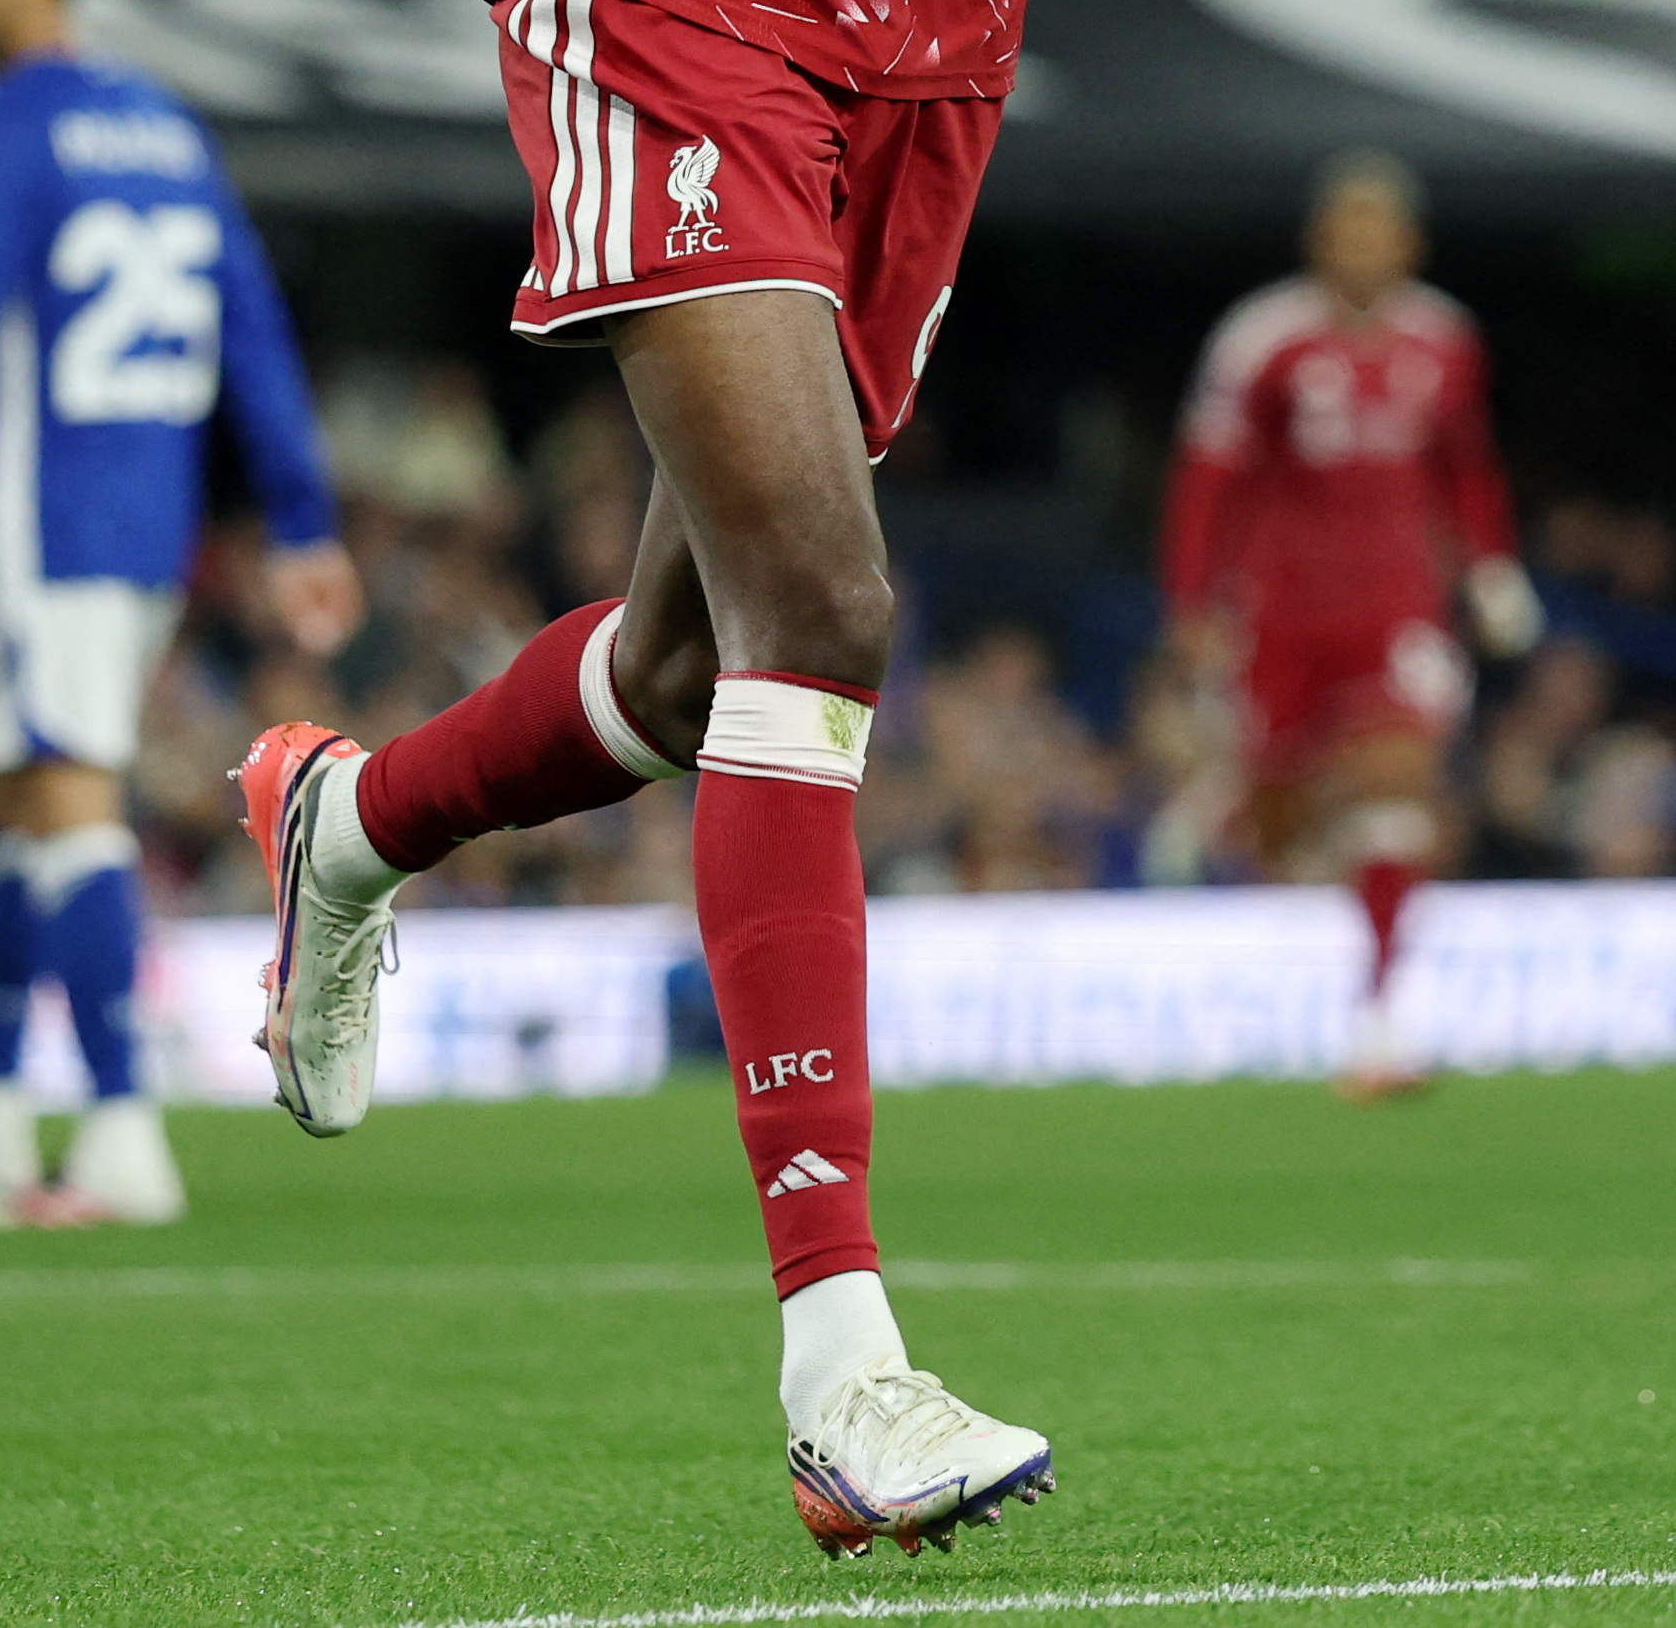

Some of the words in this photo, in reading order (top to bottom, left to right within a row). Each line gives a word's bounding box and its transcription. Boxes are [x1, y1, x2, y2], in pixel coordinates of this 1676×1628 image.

[665, 227, 730, 260] L.F.C.
[47, 200, 223, 425] 25
[745, 1048, 834, 1095] LFC
